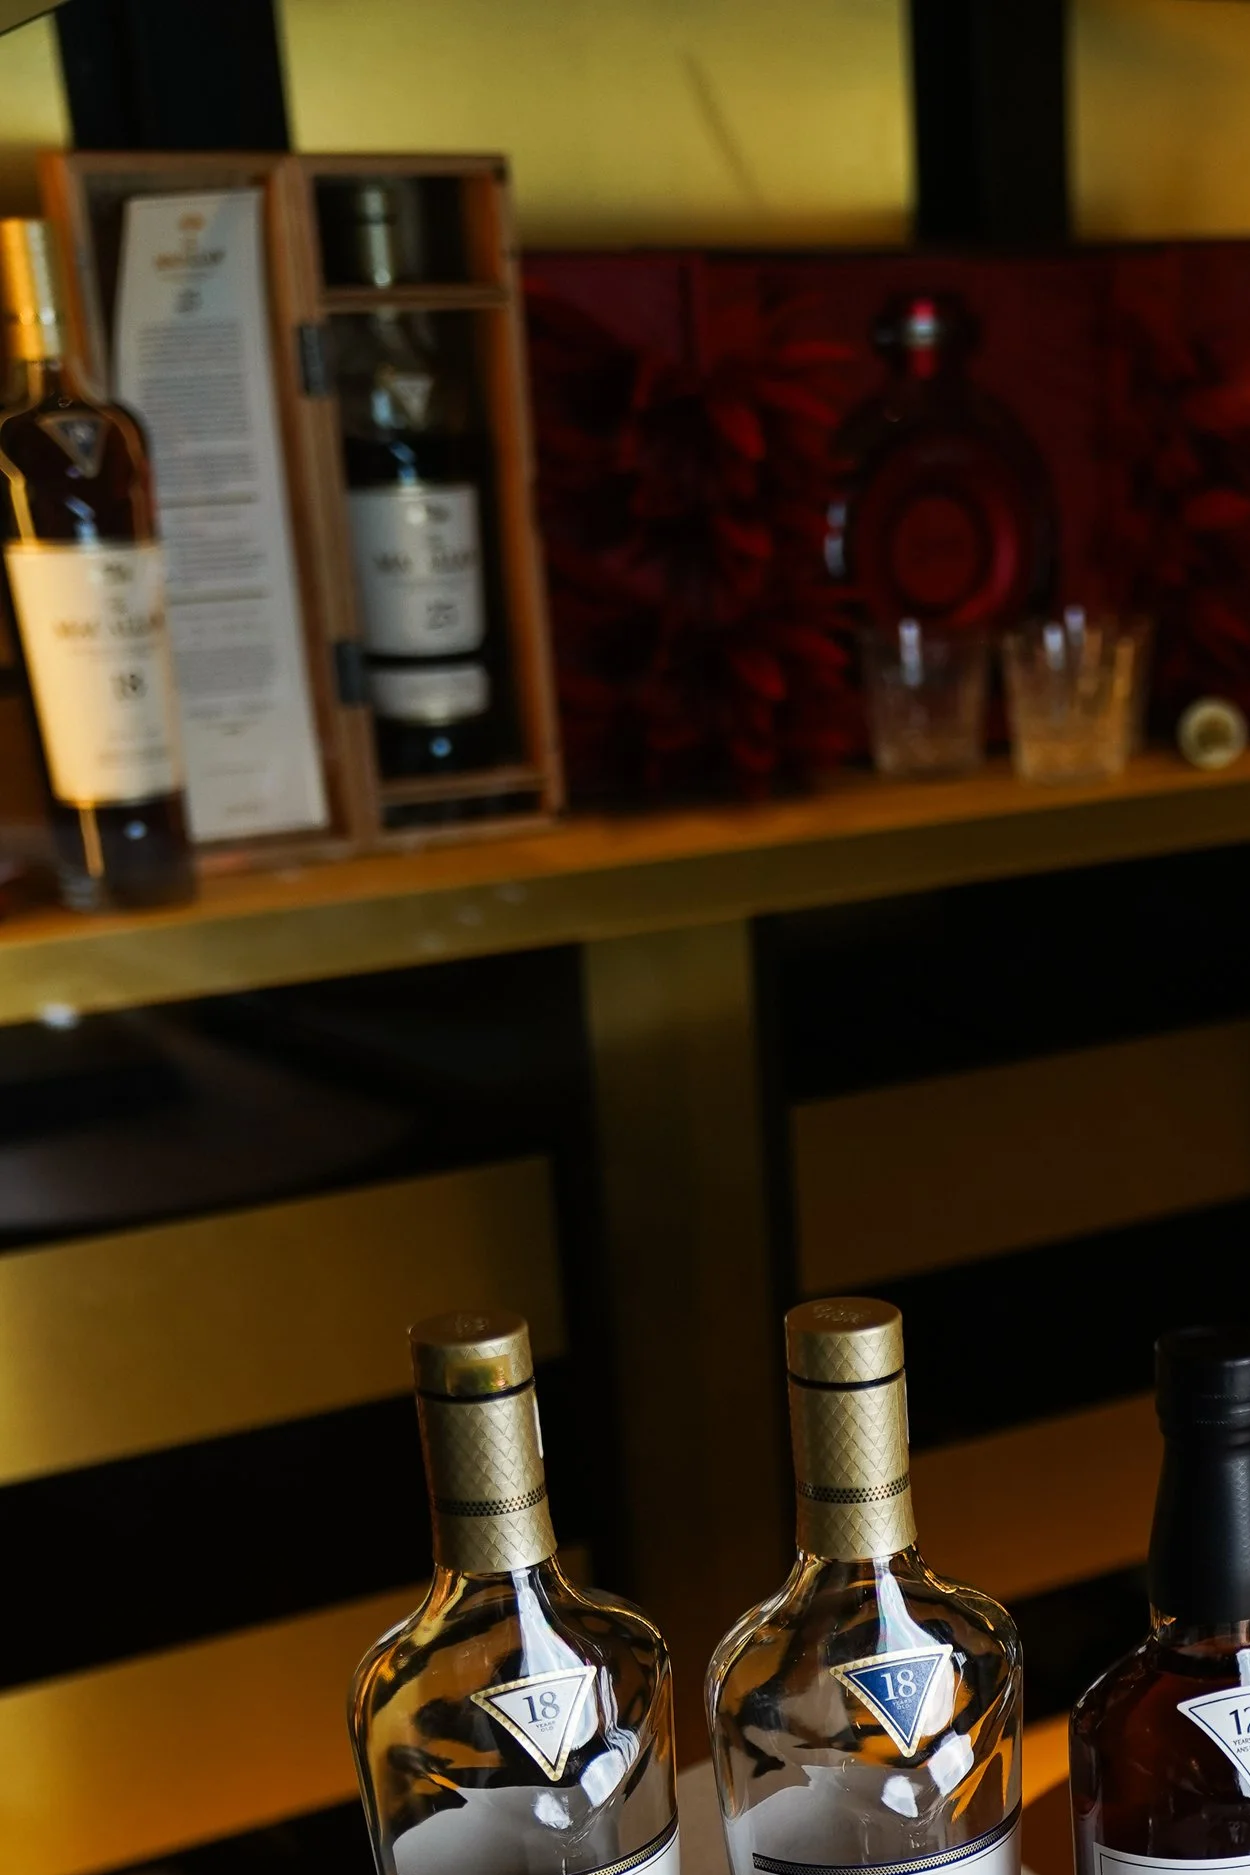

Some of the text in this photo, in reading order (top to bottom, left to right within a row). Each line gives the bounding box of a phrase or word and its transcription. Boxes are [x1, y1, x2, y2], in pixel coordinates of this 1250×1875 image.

[881, 1669, 917, 1701] 18
[523, 1691, 560, 1724] 18
[1236, 1746, 1249, 1754] ANS
